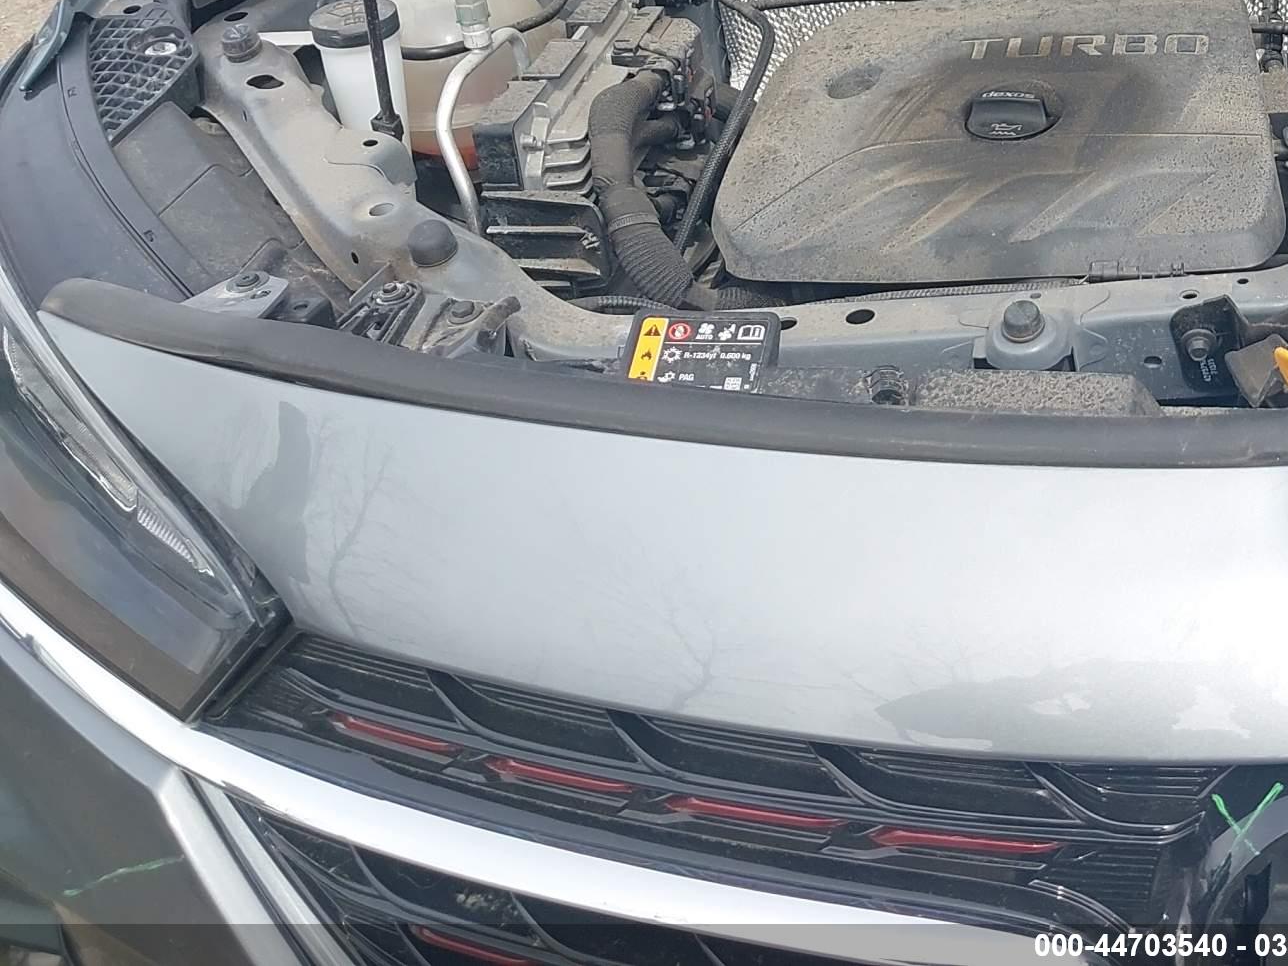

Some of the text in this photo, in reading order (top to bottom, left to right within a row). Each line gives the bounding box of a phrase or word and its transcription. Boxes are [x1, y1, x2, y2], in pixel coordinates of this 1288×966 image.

[960, 33, 1210, 60] TURBO
[982, 91, 1035, 99] dexos
[678, 373, 695, 381] PAG
